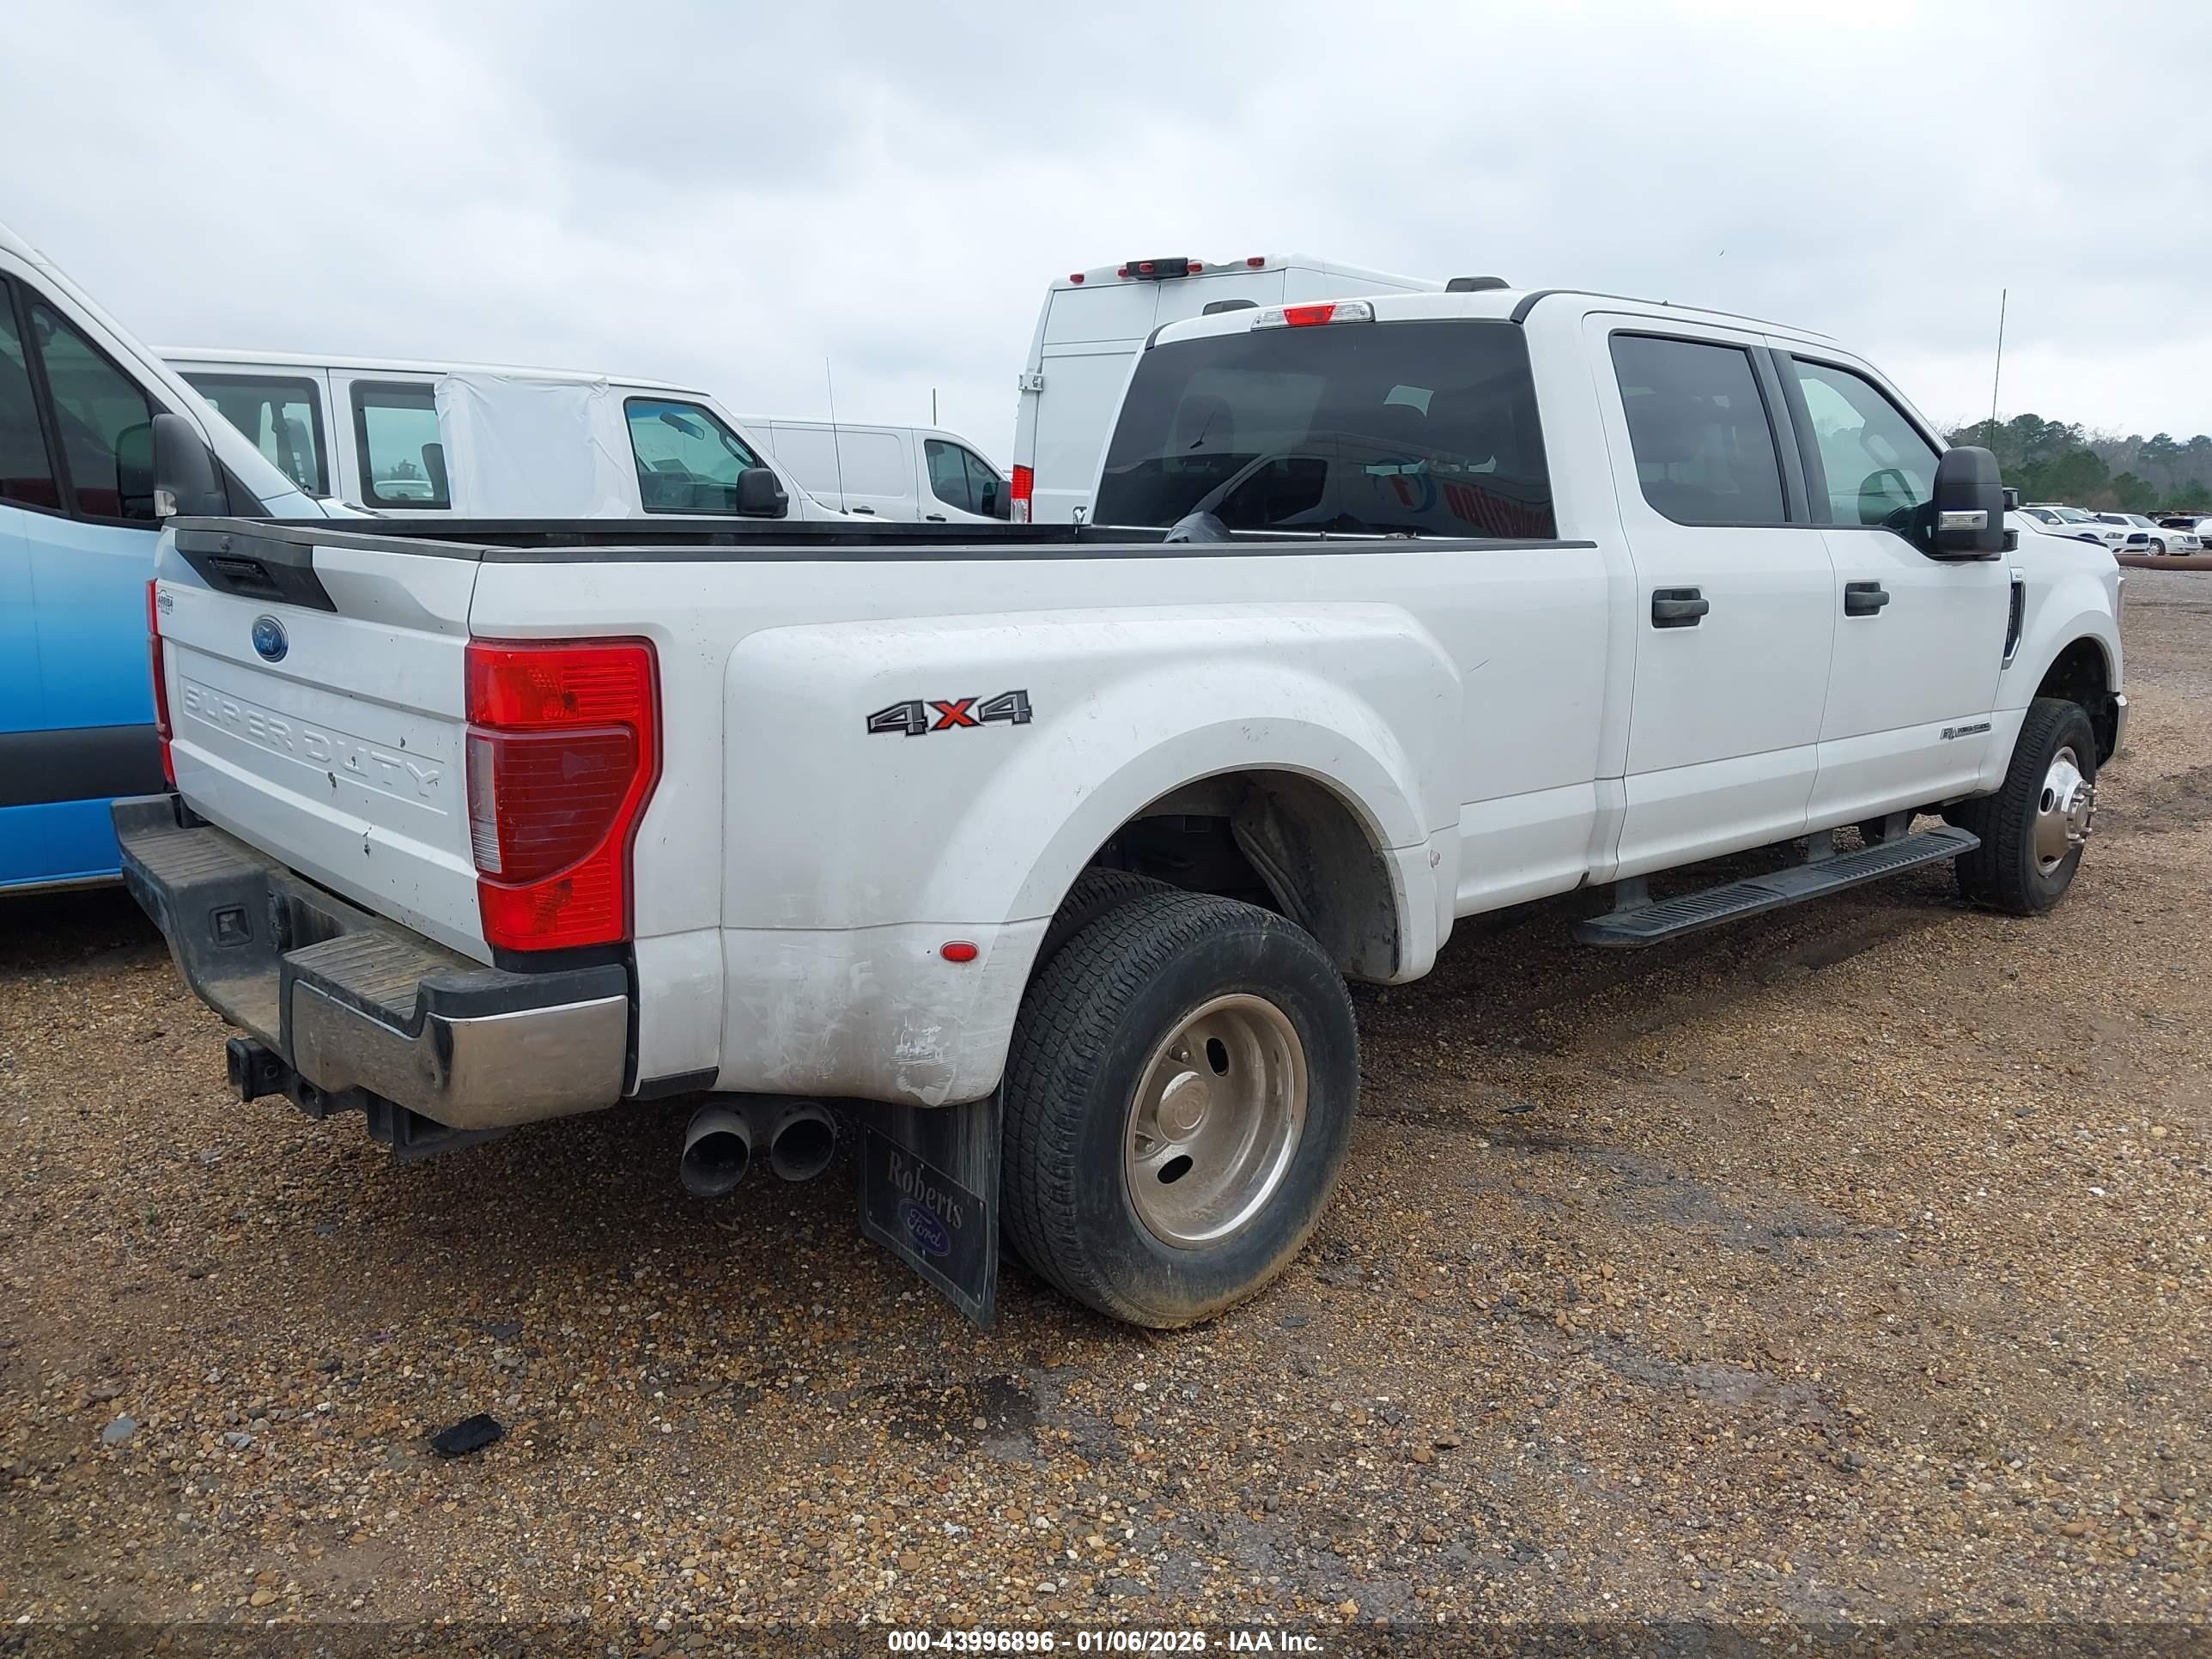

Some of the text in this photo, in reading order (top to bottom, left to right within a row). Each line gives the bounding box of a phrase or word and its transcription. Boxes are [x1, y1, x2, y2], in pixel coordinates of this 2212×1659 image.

[183, 684, 441, 799] SUPER DUTY
[887, 1150, 963, 1230] Roberts
[907, 1208, 942, 1248] Ford
